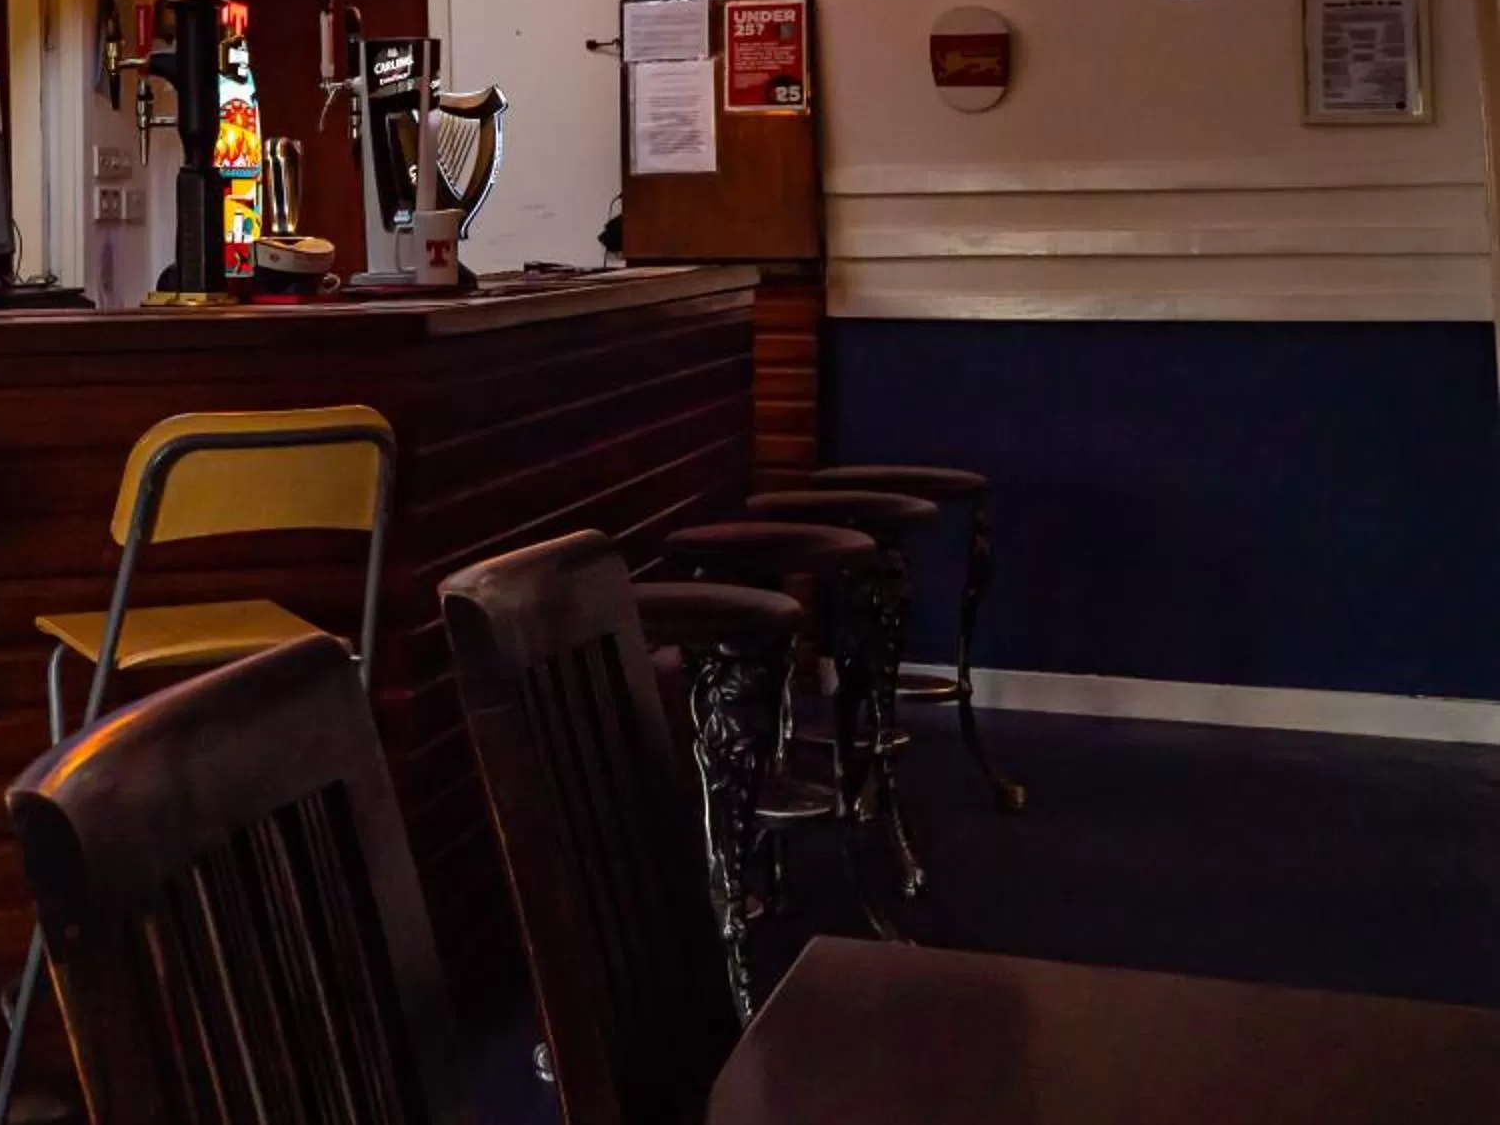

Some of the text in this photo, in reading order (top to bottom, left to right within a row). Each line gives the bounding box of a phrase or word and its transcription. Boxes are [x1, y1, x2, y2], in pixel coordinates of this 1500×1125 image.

[734, 9, 796, 23] UNDER
[734, 23, 765, 36] 25?
[775, 85, 801, 103] 25
[426, 240, 451, 267] T
